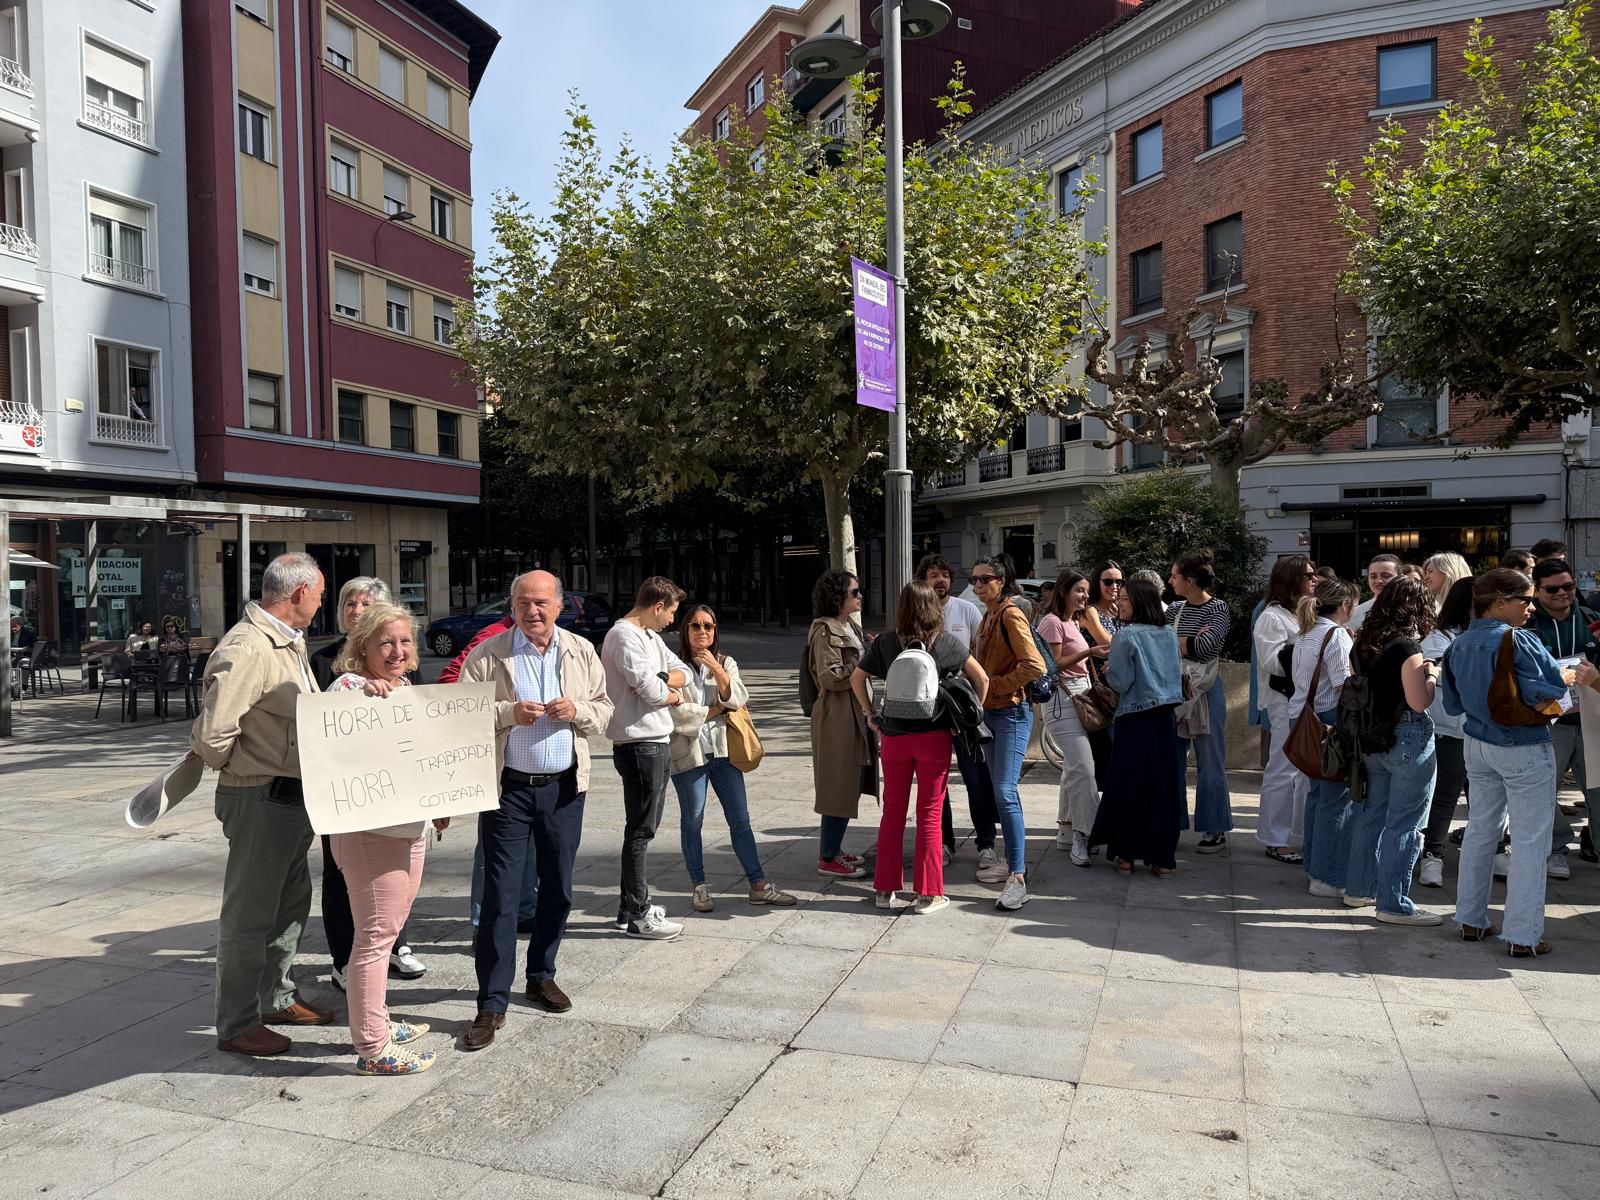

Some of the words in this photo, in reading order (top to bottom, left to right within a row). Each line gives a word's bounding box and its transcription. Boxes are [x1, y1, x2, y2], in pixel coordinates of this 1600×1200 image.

[74, 560, 139, 569] LIIDACION
[97, 573, 124, 581] OTAL
[101, 585, 137, 593] CIERRE
[323, 706, 384, 738] HORA
[392, 704, 414, 724] DE
[426, 695, 492, 719] GUARDIA
[416, 743, 494, 773] TRABAJADA
[447, 770, 456, 782] Y
[331, 769, 396, 816] HORA
[419, 784, 485, 808] COTIZADA
